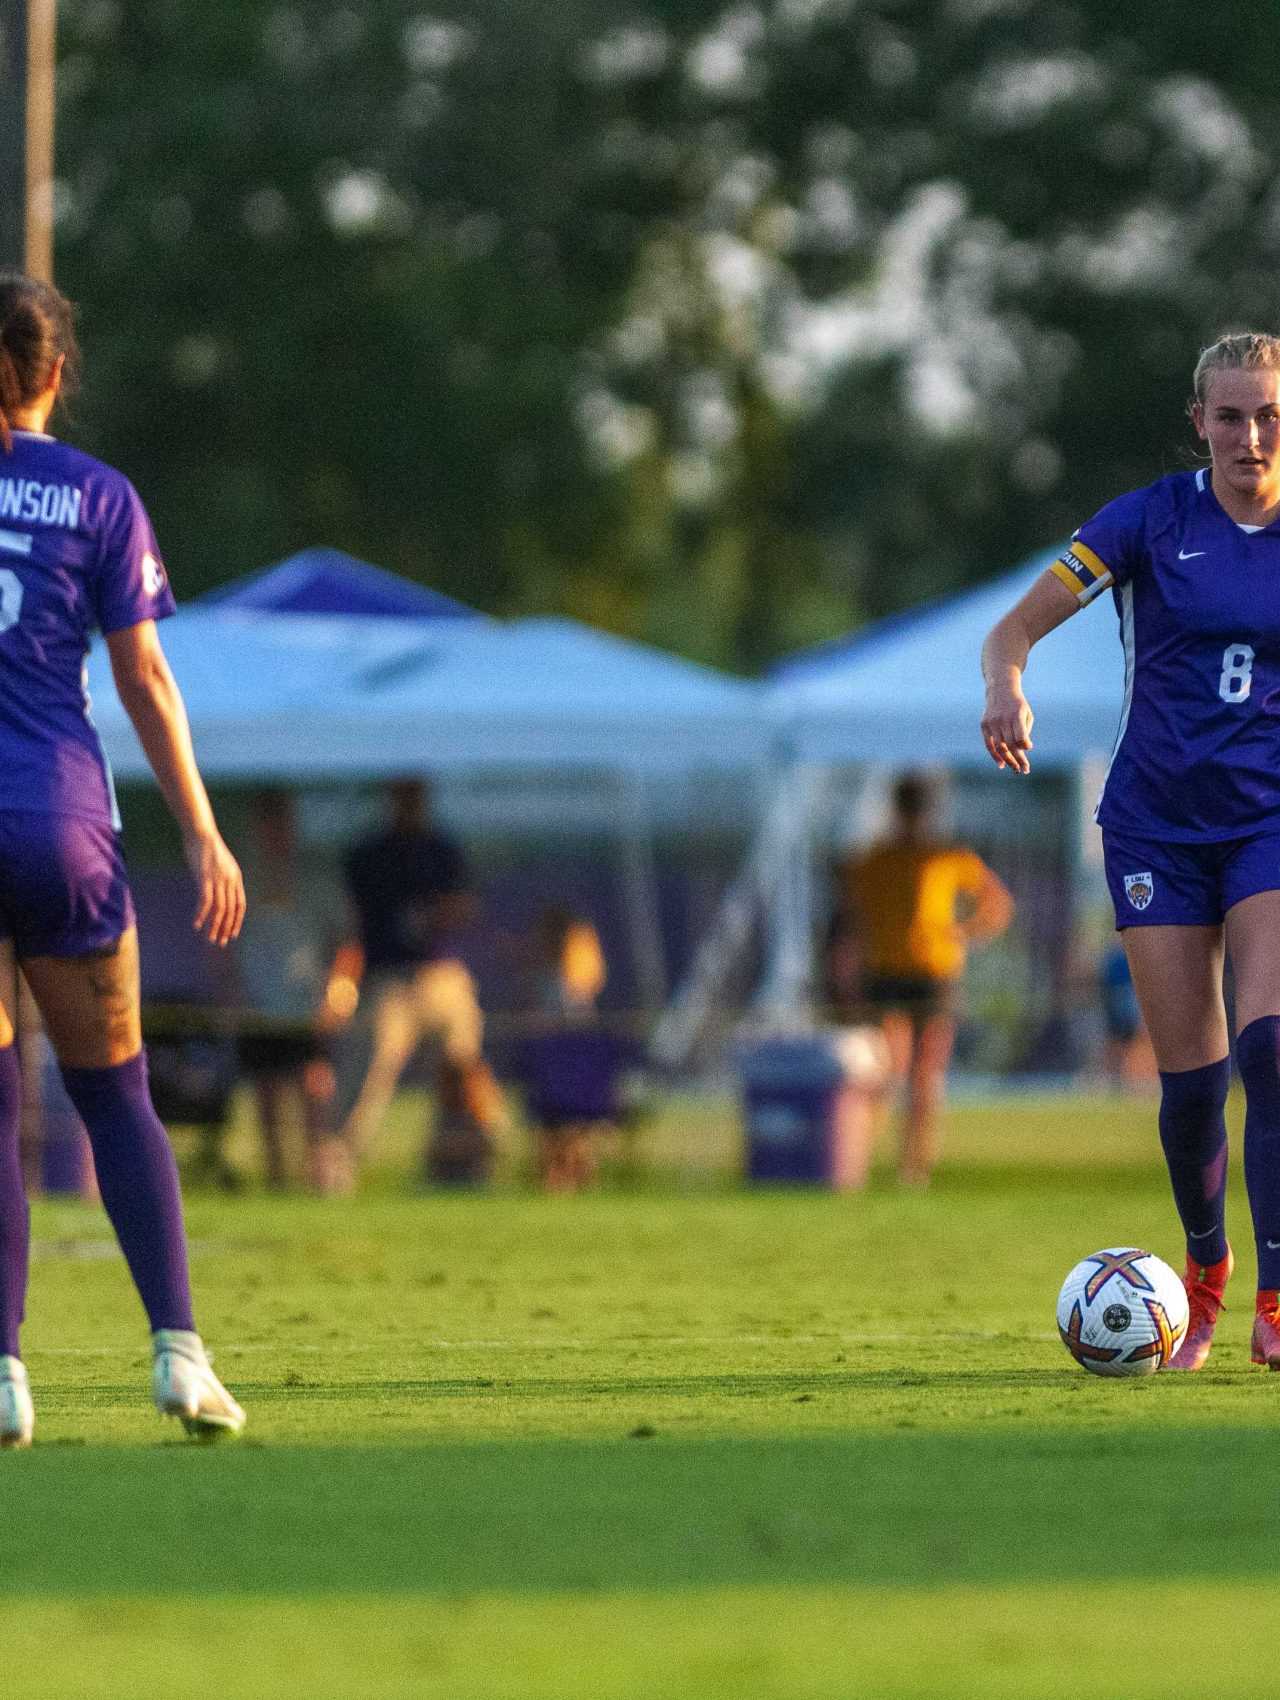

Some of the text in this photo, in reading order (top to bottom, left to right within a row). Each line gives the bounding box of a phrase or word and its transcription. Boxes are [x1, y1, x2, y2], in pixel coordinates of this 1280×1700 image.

[0, 478, 82, 530] NSON
[1063, 551, 1084, 572] AIN
[1219, 643, 1256, 704] 8
